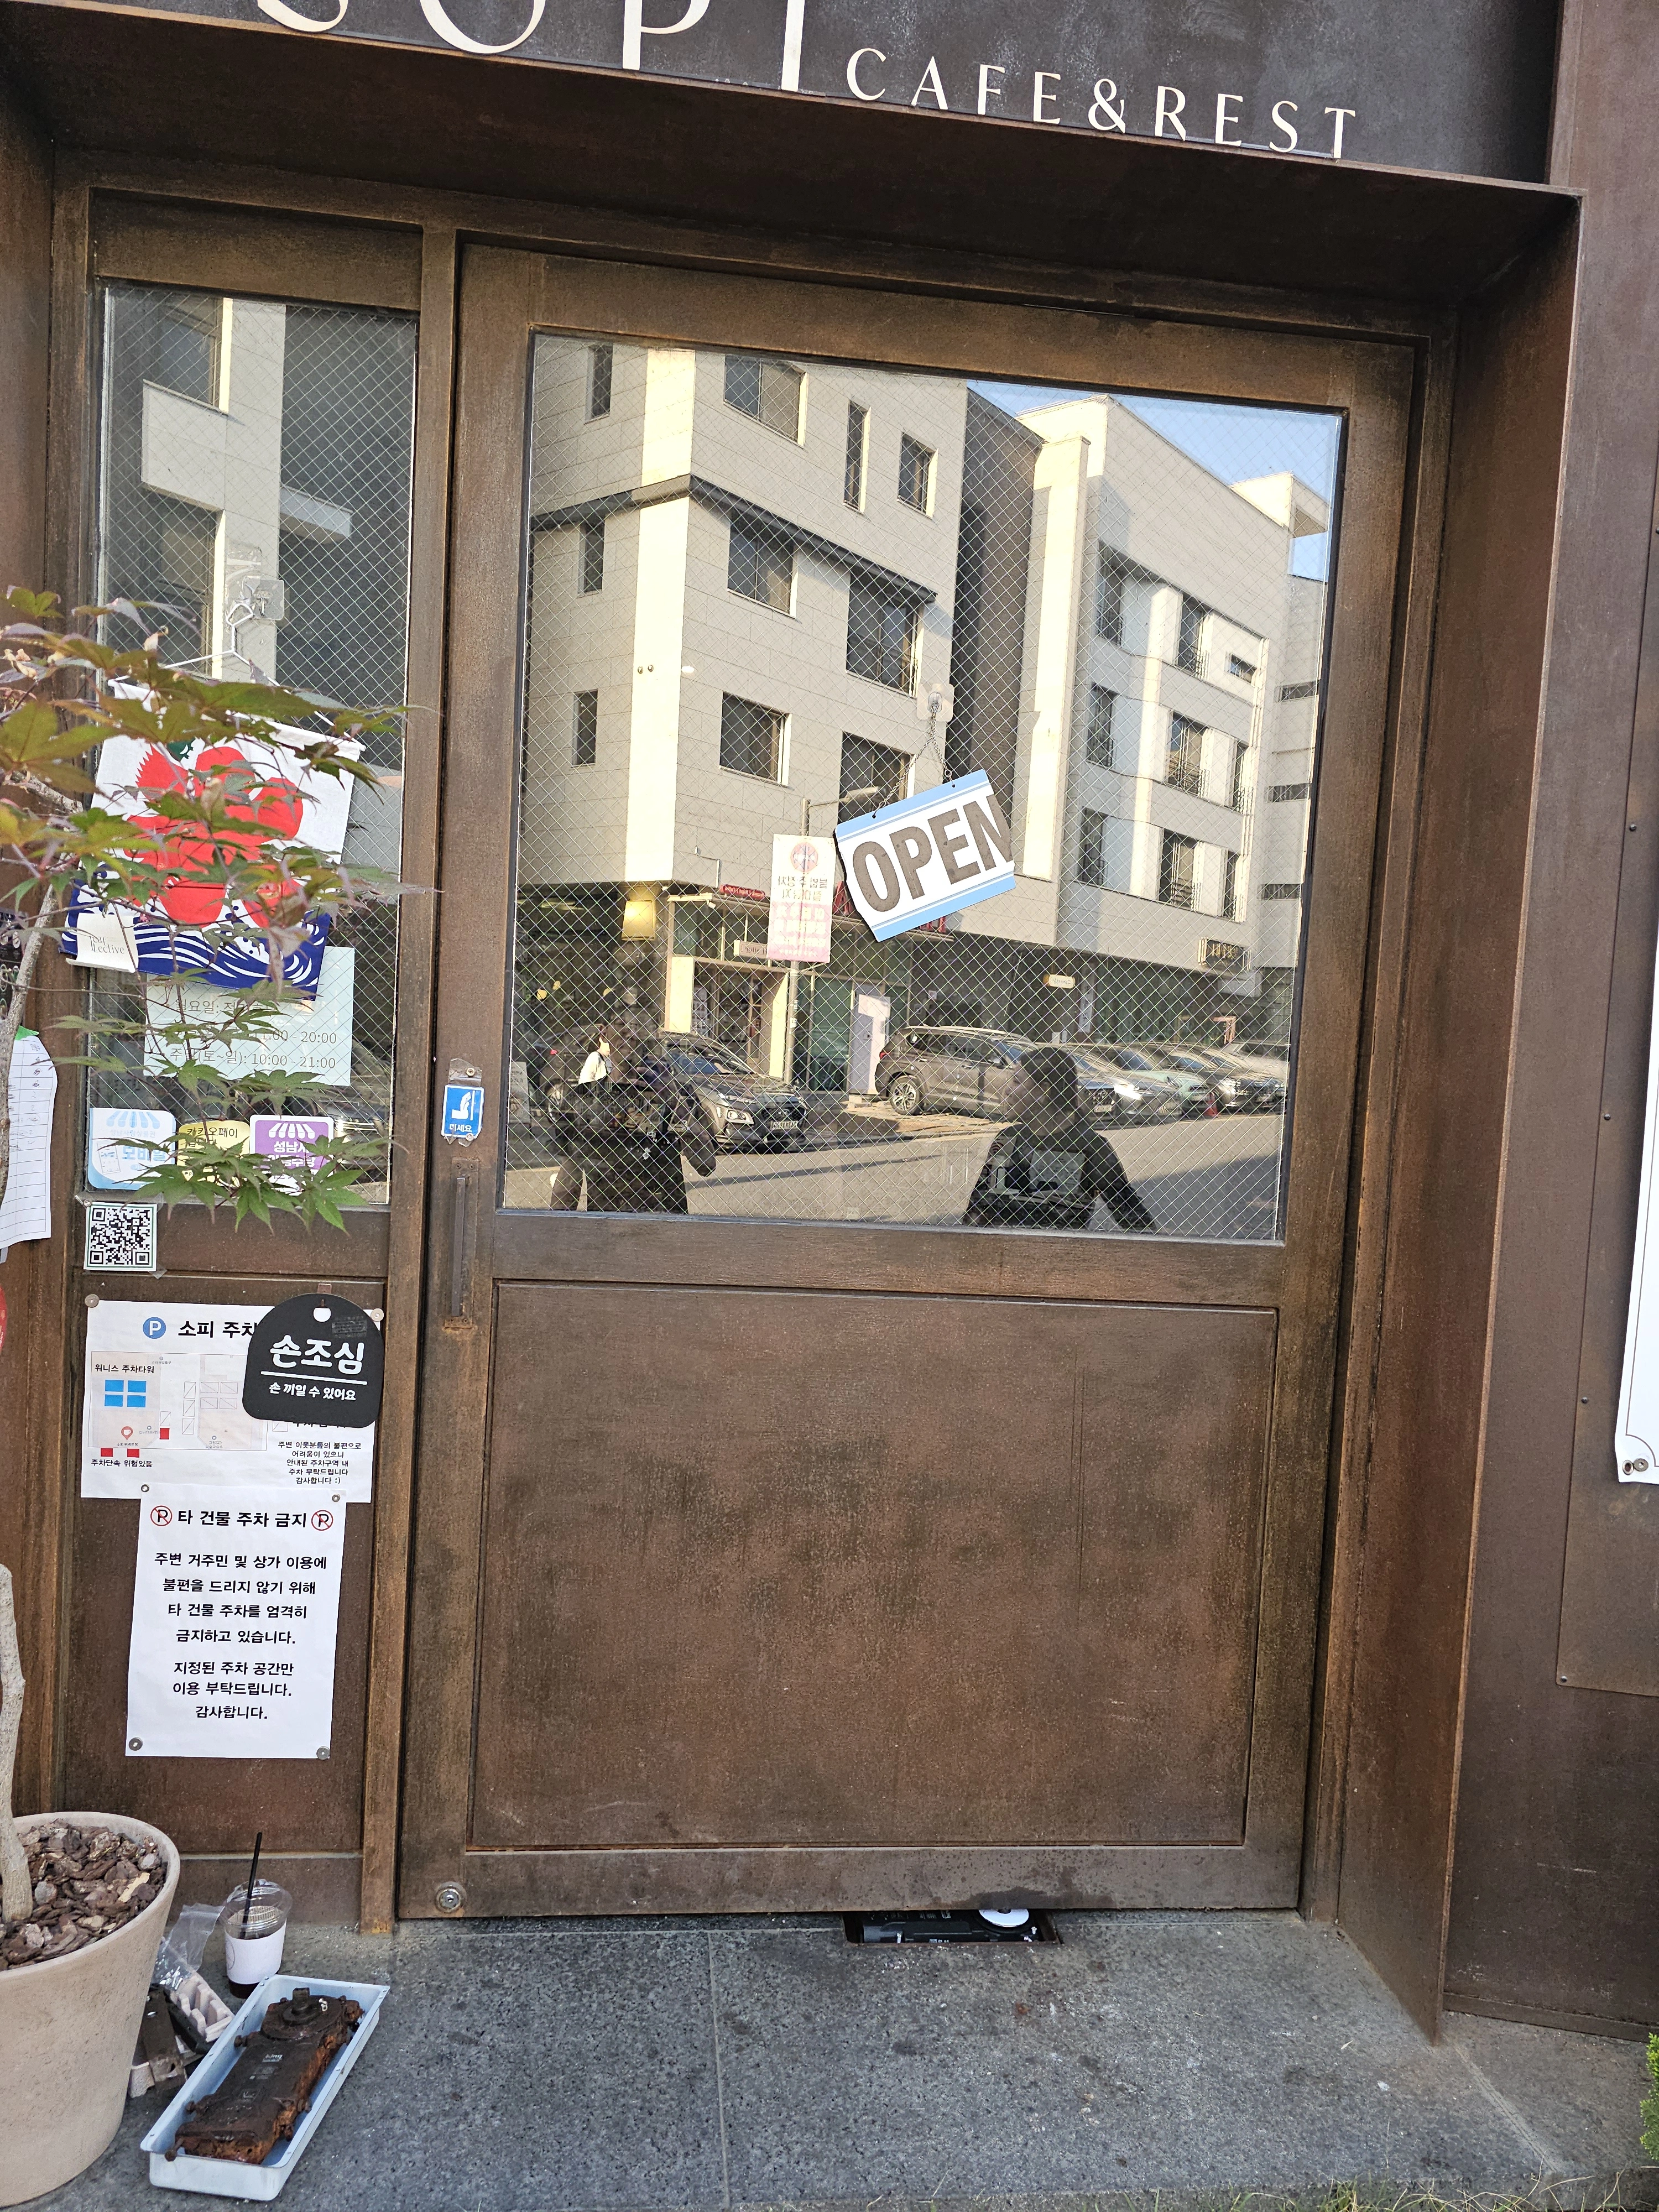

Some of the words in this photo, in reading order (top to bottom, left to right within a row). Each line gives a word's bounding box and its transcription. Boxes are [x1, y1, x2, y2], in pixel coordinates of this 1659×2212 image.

[852, 794, 1013, 912] OPEN
[174, 999, 219, 1014] 월요일:
[301, 1032, 337, 1044] 20:00
[252, 1053, 287, 1066] 10:00
[299, 1057, 336, 1068] 21:00
[449, 1123, 472, 1132] 미세요
[178, 1321, 214, 1338] 소피
[270, 1334, 364, 1375] 손조심
[95, 1364, 119, 1373] 워니스
[122, 1365, 155, 1374] 주차타워
[269, 1382, 281, 1394] 손
[283, 1384, 306, 1397] 끼일
[309, 1386, 321, 1398] 수
[323, 1387, 356, 1401] 있어요
[91, 1459, 121, 1467] 주차단속
[124, 1459, 153, 1468] 위험있음
[178, 1510, 193, 1525] 타
[200, 1510, 231, 1526] 건물
[236, 1512, 269, 1528] 주차
[275, 1512, 307, 1528] 금지
[154, 1552, 181, 1566] 주변
[188, 1553, 228, 1568] 거주민
[234, 1556, 247, 1569] 및
[253, 1555, 281, 1569] 상가
[286, 1556, 327, 1570] 이용에
[163, 1578, 204, 1592] 불편을
[208, 1580, 251, 1594] 드리지
[256, 1580, 283, 1595] 않기
[289, 1580, 316, 1595] 위해
[168, 1604, 181, 1616] 타
[187, 1604, 214, 1618] 건물
[220, 1604, 261, 1619] 주차를
[267, 1605, 307, 1619] 엄격히
[176, 1629, 232, 1643] 금지하고
[237, 1630, 296, 1645] 있습니다.
[173, 1662, 215, 1675] 지정된
[221, 1662, 248, 1676] 주차
[253, 1662, 294, 1676] 공간만
[173, 1682, 200, 1695] 이용
[205, 1682, 291, 1697] 부탁드립니다.
[195, 1706, 268, 1719] 감사합니다.
